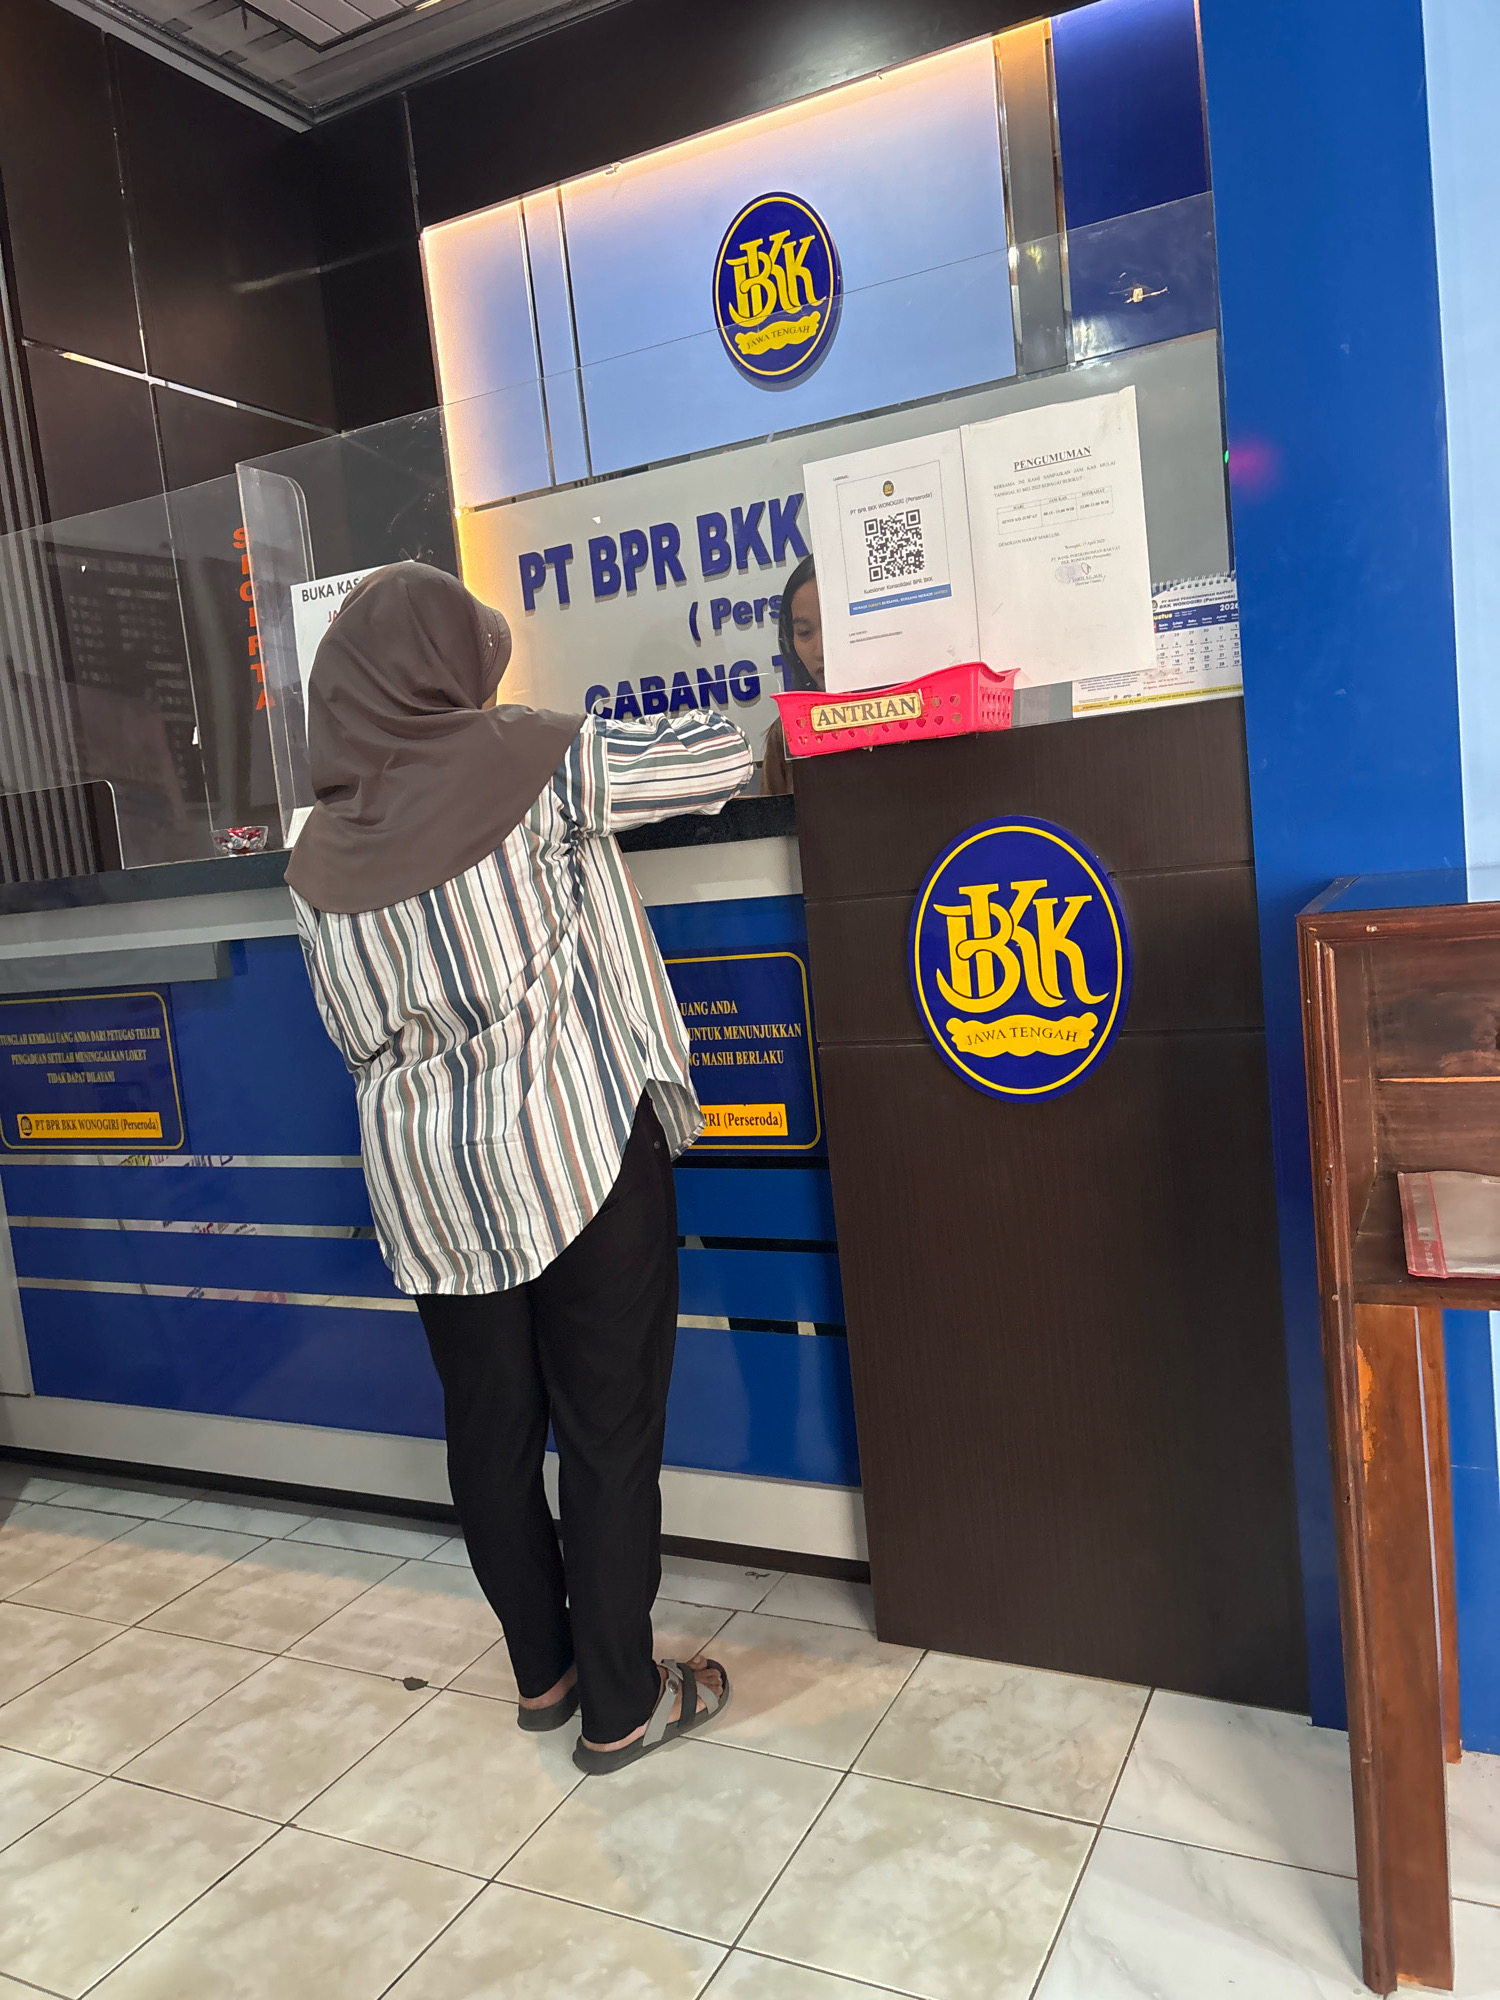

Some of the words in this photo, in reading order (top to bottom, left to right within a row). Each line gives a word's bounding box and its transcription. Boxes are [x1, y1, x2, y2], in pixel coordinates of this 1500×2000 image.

[746, 334, 770, 350] JAWA
[771, 325, 811, 339] TENGAH
[1013, 446, 1092, 471] PENGUMUMAN
[850, 508, 857, 516] PT
[518, 543, 574, 611] PT
[588, 522, 687, 598] BPR
[696, 493, 810, 577] BKK
[301, 584, 335, 602] BUKA
[585, 659, 761, 719] CABANG
[816, 696, 917, 727] ANTRIAN
[710, 1000, 738, 1015] ANDA
[74, 1031, 90, 1042] ANDA
[90, 1030, 106, 1042] DARI
[107, 1028, 136, 1042] PETUGAS
[135, 1027, 162, 1040] TELLER
[723, 1023, 802, 1040] MENUNJUKKAN
[967, 1028, 1008, 1046] JAWA
[1009, 1026, 1079, 1042] TENGAH
[124, 1048, 146, 1062] LOKET
[701, 1051, 734, 1066] MASIH
[736, 1050, 784, 1065] BERLAKU
[46, 1072, 66, 1084] TIDAK
[66, 1072, 85, 1084] DAPAT
[35, 1120, 46, 1131] PT
[46, 1119, 60, 1130] BPR
[62, 1118, 77, 1130] BKK
[78, 1118, 120, 1130] WONOGIRI
[121, 1118, 159, 1132] (Perseroda)
[723, 1110, 783, 1130] (Perseroda)
